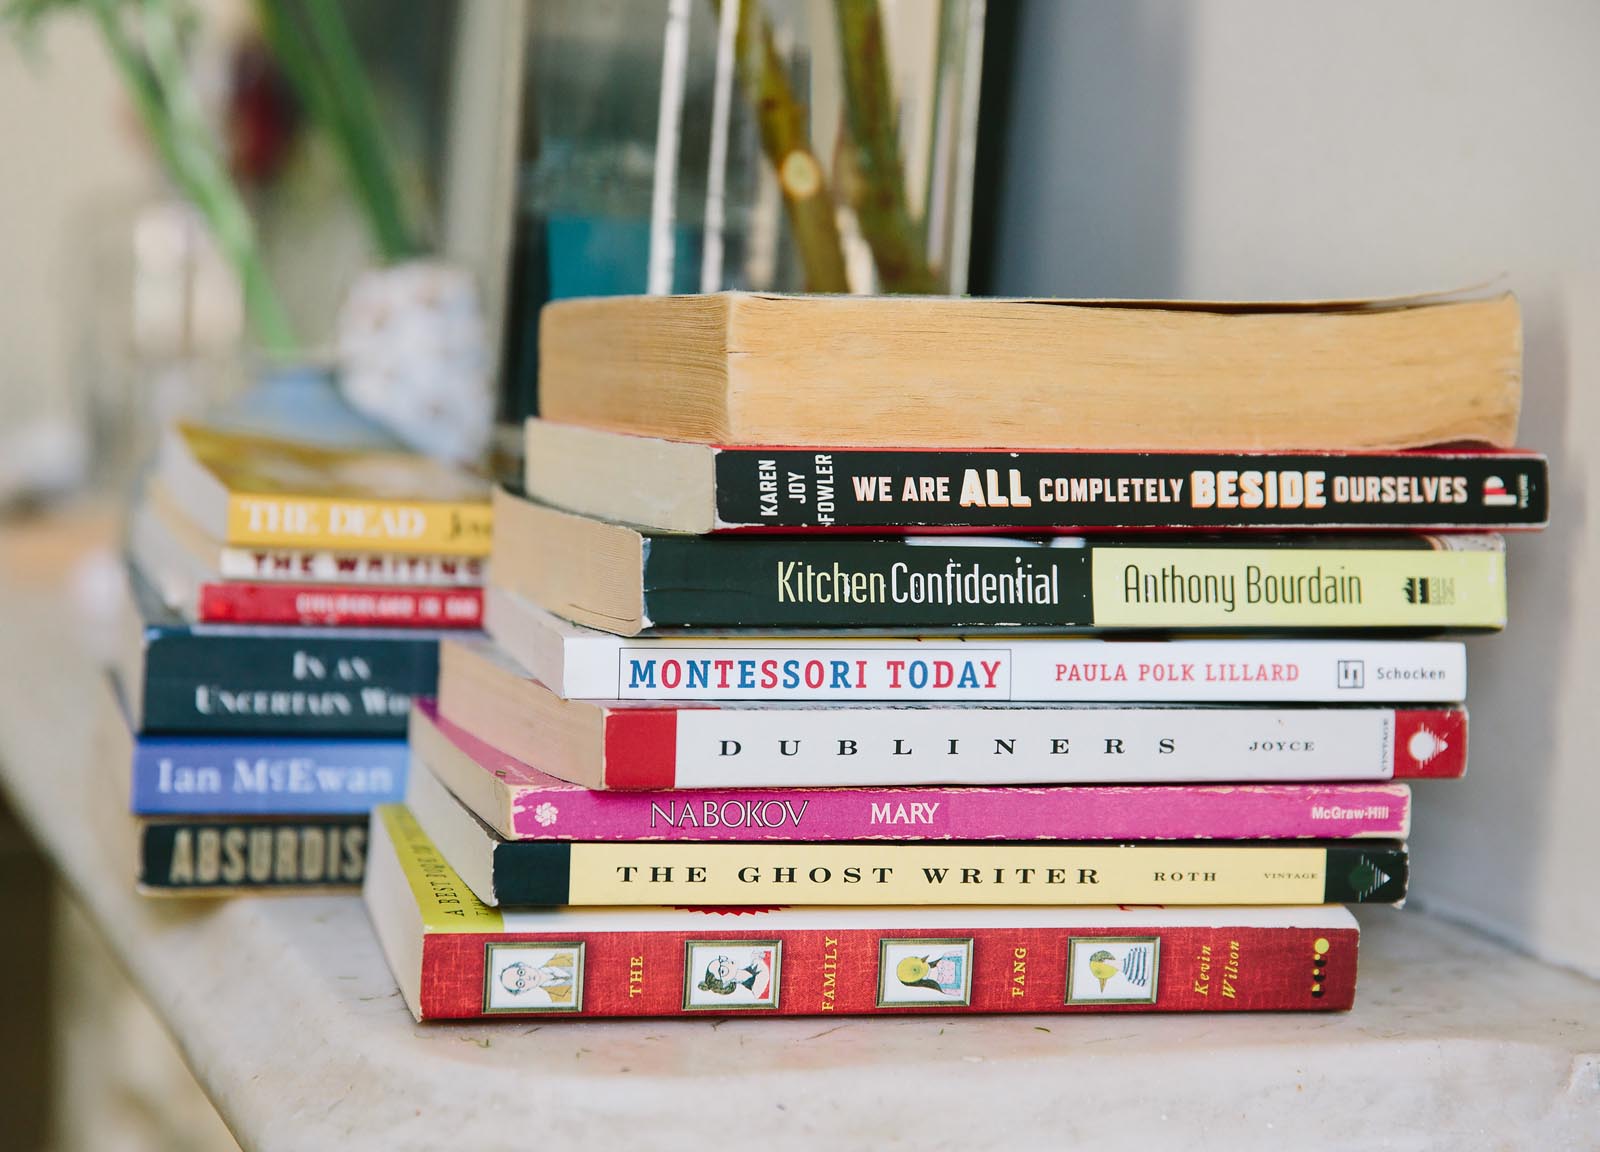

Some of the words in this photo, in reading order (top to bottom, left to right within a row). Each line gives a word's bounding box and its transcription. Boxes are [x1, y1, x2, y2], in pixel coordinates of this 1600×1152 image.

[758, 459, 778, 517] KAREN
[788, 471, 806, 504] JOY
[815, 454, 835, 525] FOWLER
[852, 476, 893, 502] WE
[901, 476, 950, 502] ARE
[959, 468, 1032, 508] ALL
[1039, 478, 1184, 503] COMPLETELY
[1190, 470, 1327, 509] BESIDE
[1333, 476, 1468, 503] OURSELVES
[240, 502, 319, 535] THE
[329, 504, 426, 538] DEAD
[253, 552, 315, 573] THE
[777, 561, 885, 603] Kitchen
[891, 562, 1058, 605] Confidential
[1124, 564, 1235, 612] Anthony
[1246, 565, 1362, 605] Bourdain
[628, 659, 867, 689] MONTESSORI
[886, 660, 1002, 689] TODAY
[1055, 663, 1127, 682] PAULA
[1138, 664, 1195, 682] POLK
[1205, 664, 1299, 682] LILLARD
[1377, 667, 1446, 680] Schocken
[719, 738, 1176, 757] DUBLINERS
[1248, 741, 1315, 752] JOYCE
[157, 759, 221, 793] Ian
[234, 757, 393, 793] McEwan
[650, 800, 810, 828] NABOKOV
[870, 803, 940, 825] MARY
[1312, 806, 1389, 820] McGraw-Hill
[617, 866, 708, 884] THE
[738, 866, 894, 884] GHOST
[922, 867, 1100, 884] WRITER
[1153, 871, 1217, 882] ROTH
[1263, 872, 1319, 880] VINTAGE
[430, 881, 460, 904] BEST
[629, 956, 644, 998] THE
[822, 936, 838, 1011] FAMILY
[1012, 946, 1027, 998] FANG
[1194, 945, 1211, 997] Kevin
[1222, 940, 1240, 999] Wilson
